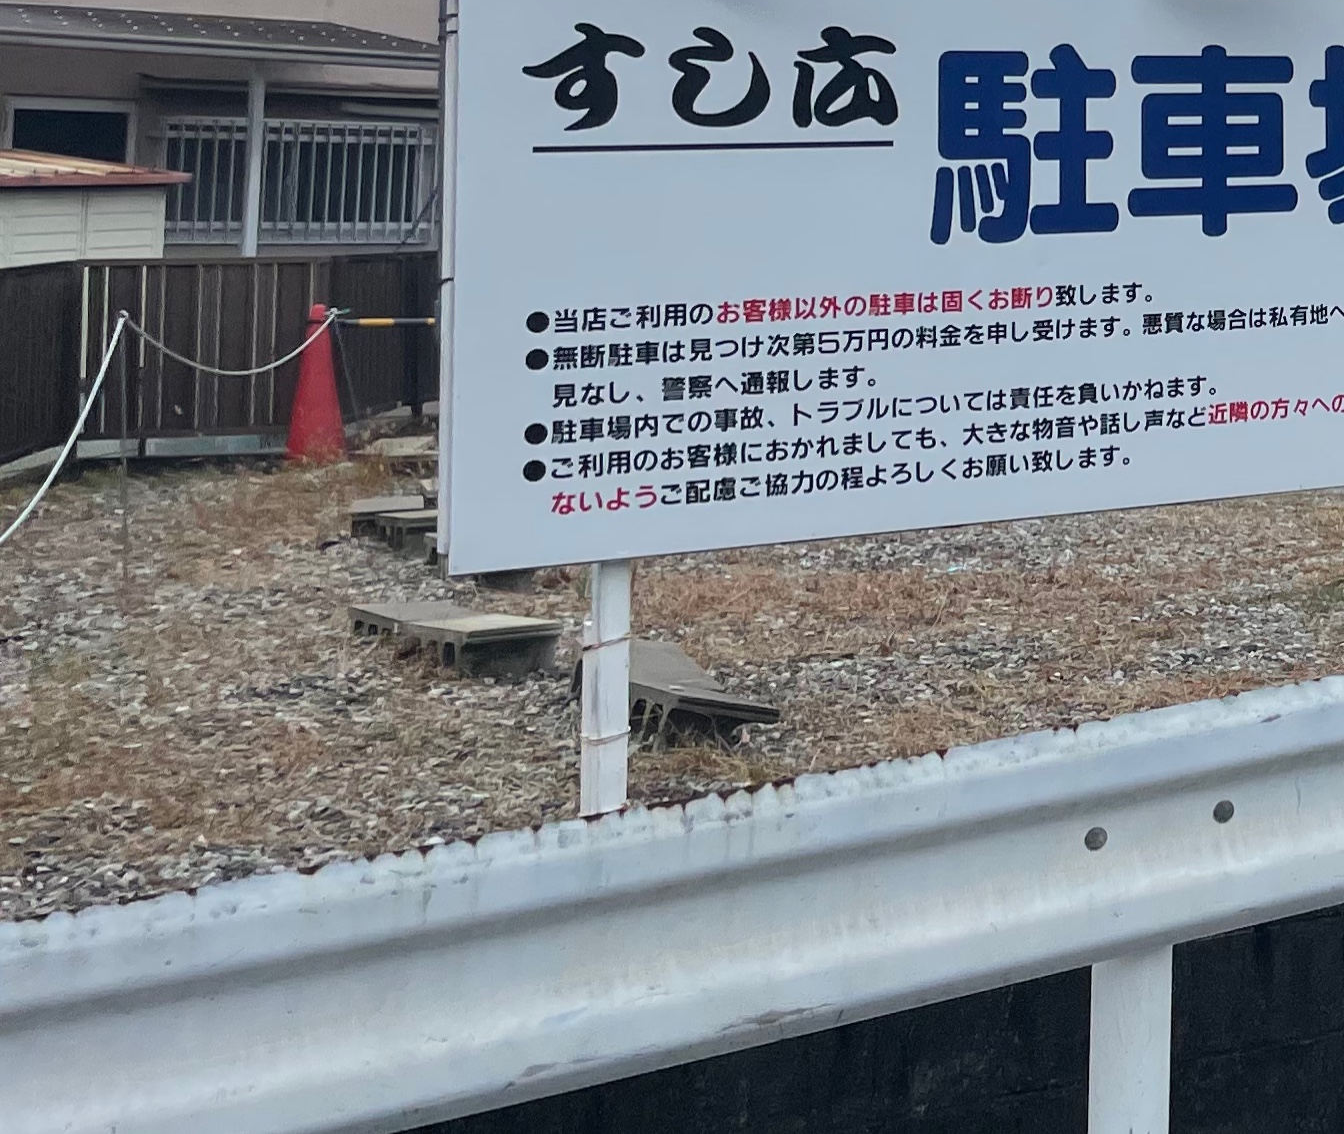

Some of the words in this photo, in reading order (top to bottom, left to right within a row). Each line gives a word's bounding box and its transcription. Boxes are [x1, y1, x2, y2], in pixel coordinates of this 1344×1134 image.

[520, 22, 900, 132] すし広
[553, 281, 1155, 334] 当店ご利用のお客様以外の駐車は固くお断り致します。
[551, 375, 1218, 445] 駐車場内での事故、トラブルについては責任を負いかねます。
[553, 365, 879, 408] 見なし、警察へ通報します。
[551, 444, 1132, 515] ないようご配慮ご協力の程よろしくお願い致します。
